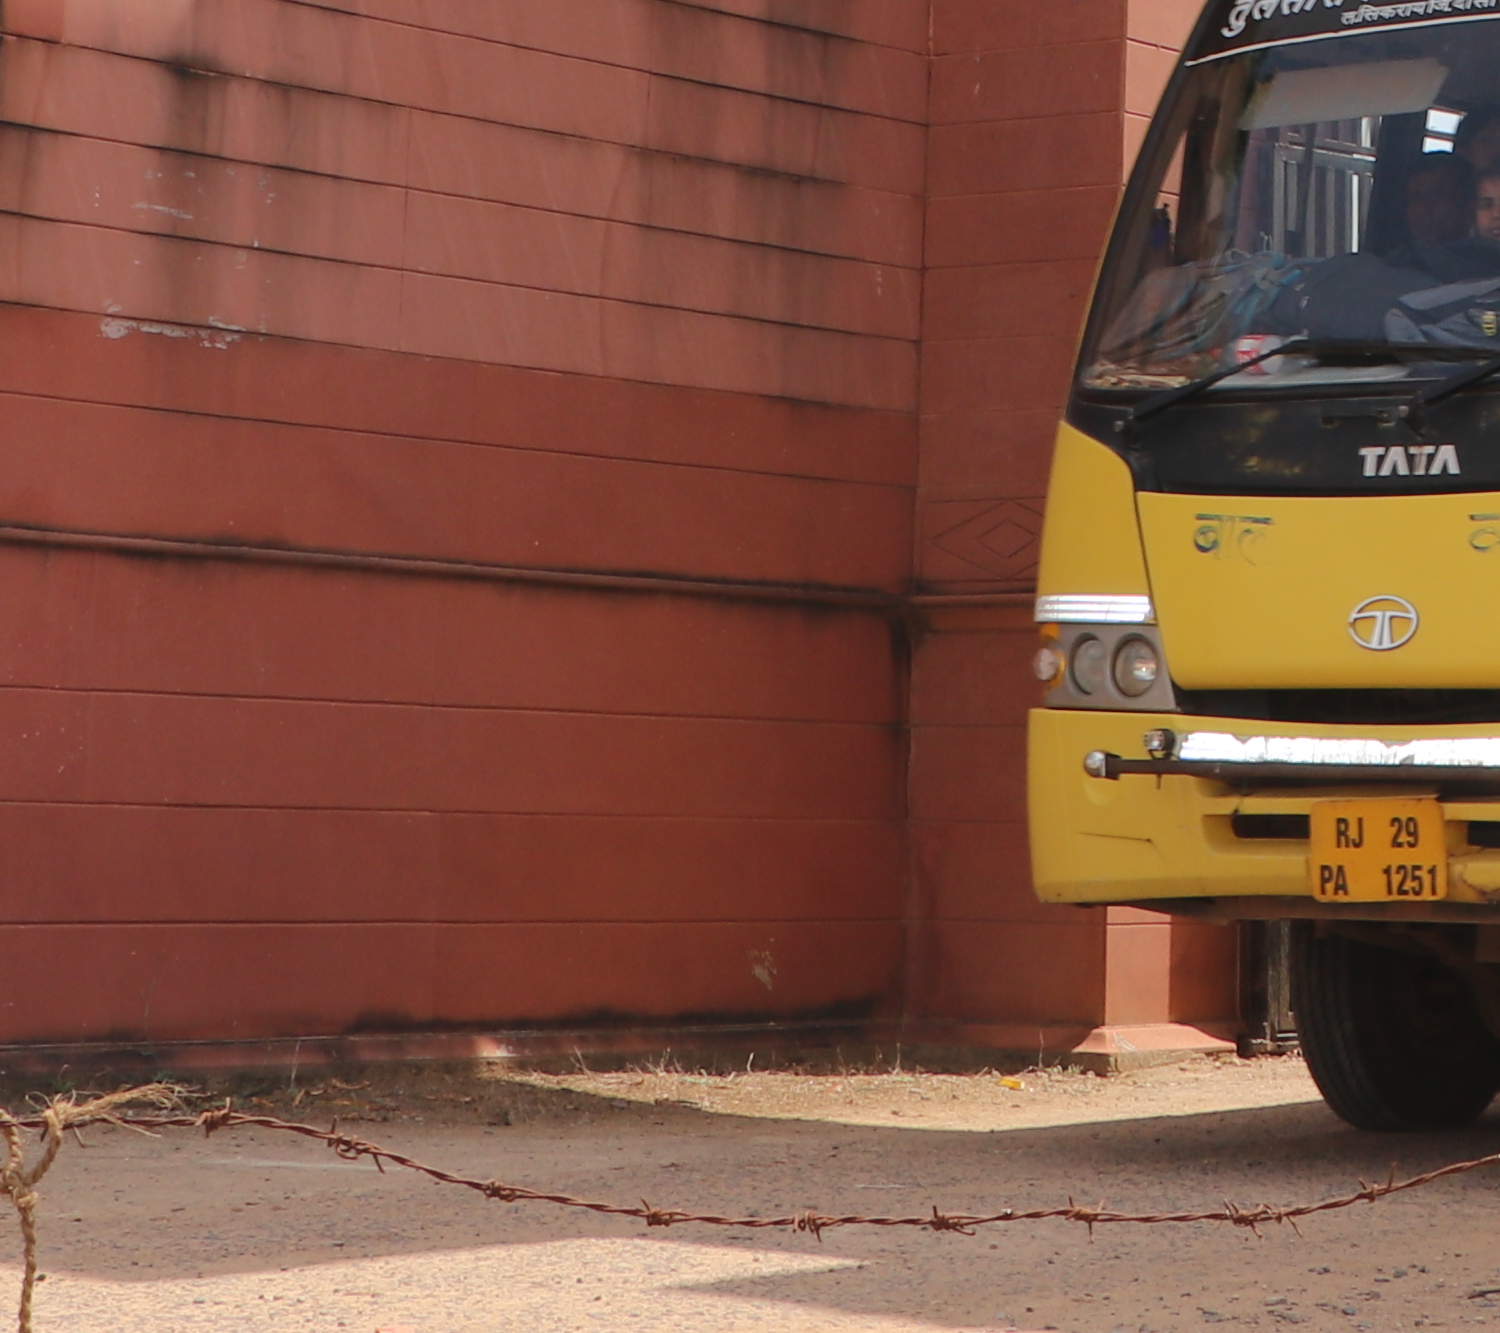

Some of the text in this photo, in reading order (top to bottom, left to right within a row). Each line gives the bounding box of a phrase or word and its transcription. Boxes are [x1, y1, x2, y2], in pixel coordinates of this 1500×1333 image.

[1358, 445, 1461, 476] TATA
[1336, 817, 1419, 848] RJ 29
[1320, 864, 1438, 896] PA 1251
